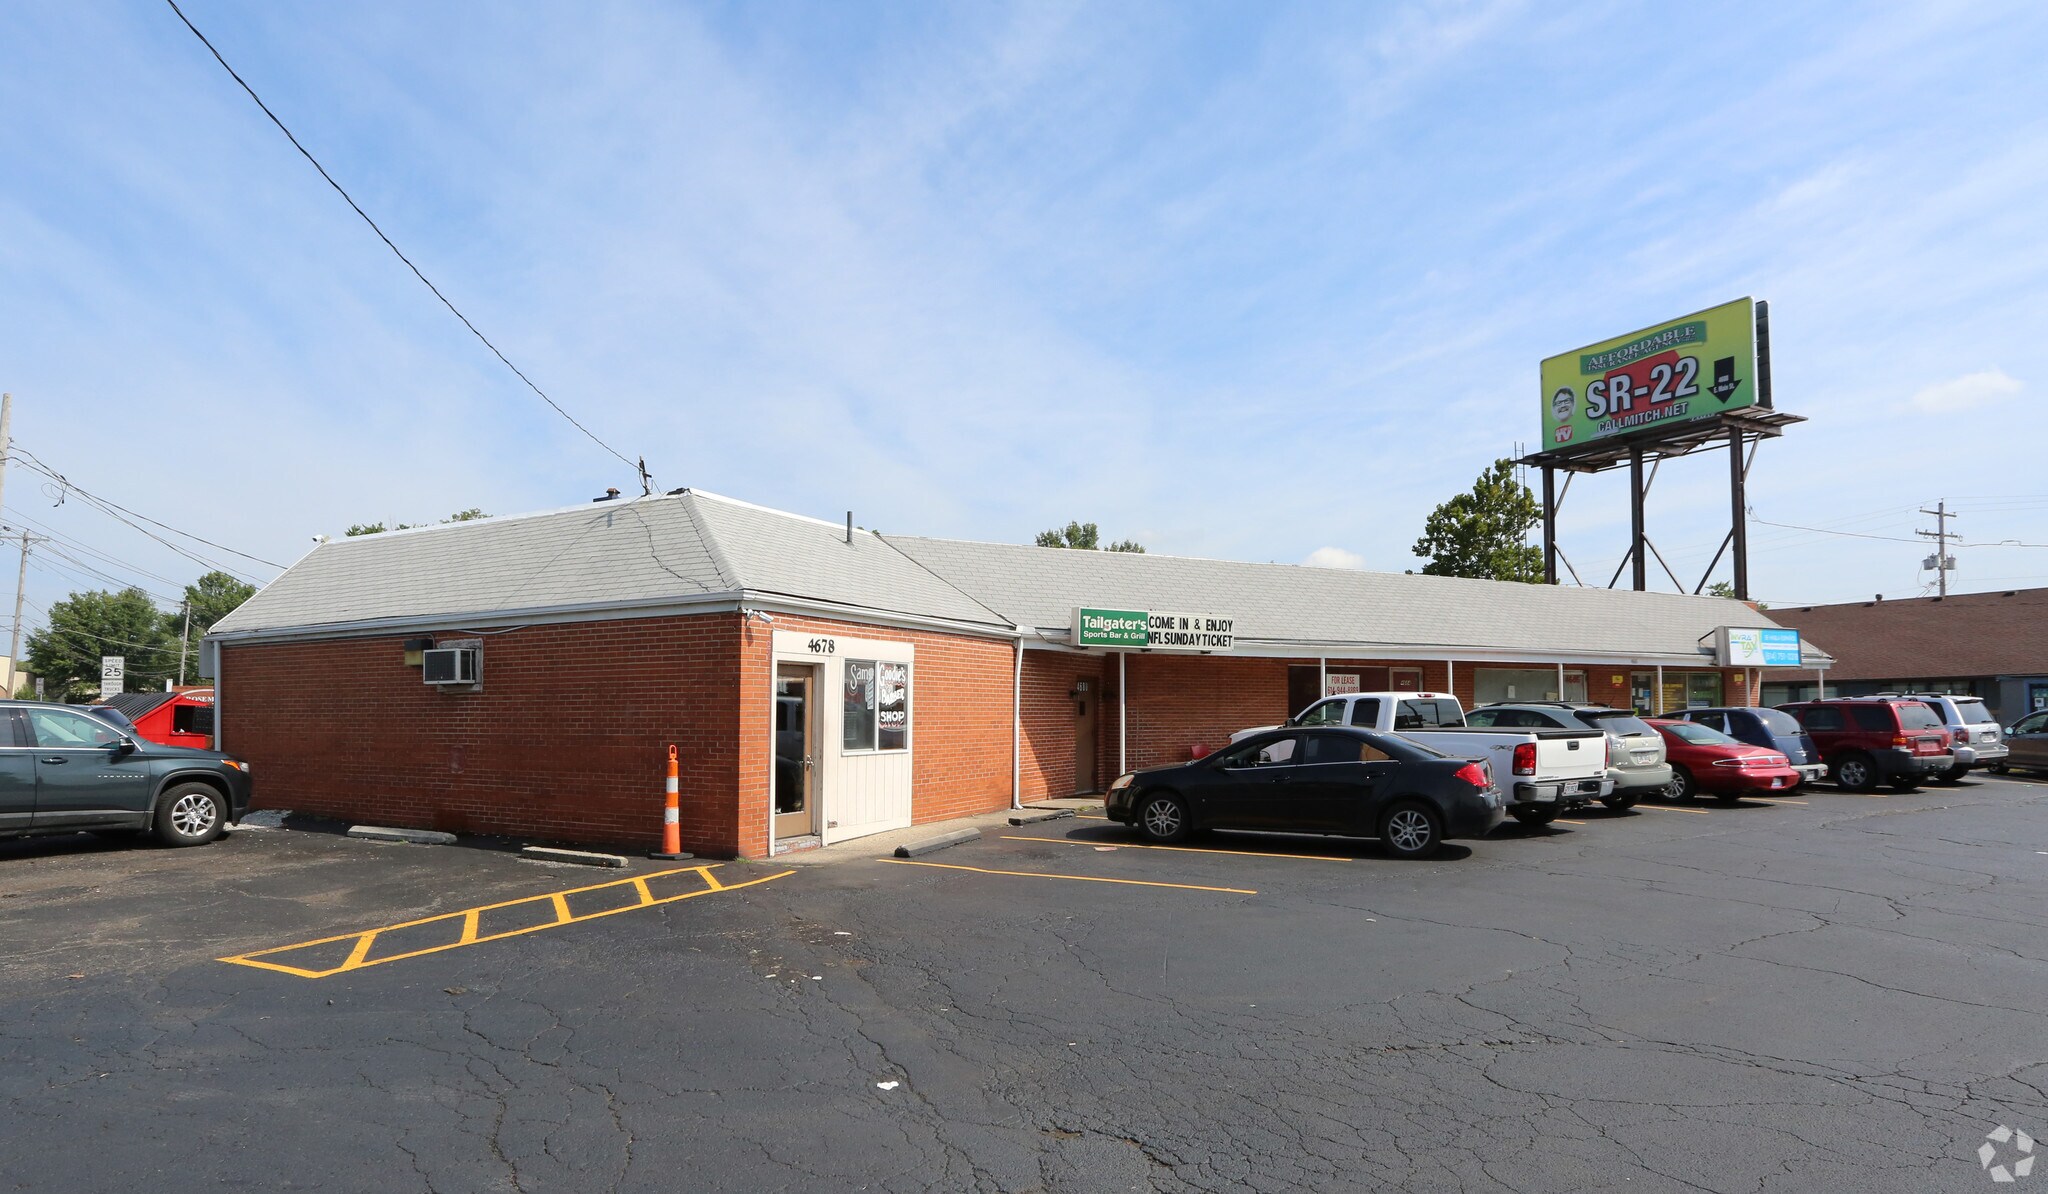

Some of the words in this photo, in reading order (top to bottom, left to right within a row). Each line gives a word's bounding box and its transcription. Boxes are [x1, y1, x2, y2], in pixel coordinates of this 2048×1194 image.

[1588, 325, 1696, 366] AFFORDABLE
[1588, 350, 1639, 371] INSURANCE
[1642, 337, 1681, 353] AGENCY
[1586, 356, 1699, 419] SR-22
[1597, 402, 1688, 432] CALLMITCH.NET
[1082, 615, 1147, 632] Tailgater's
[1149, 616, 1175, 630] COME
[1179, 617, 1189, 630] IN
[1194, 618, 1201, 631] &
[1206, 619, 1233, 632] ENJOY
[1083, 631, 1108, 640] Sports
[1130, 632, 1146, 640] Grill
[1147, 631, 1163, 644] NFL
[1164, 632, 1201, 646] SUNDAY
[1202, 634, 1233, 647] TICKET
[807, 638, 835, 653] 4678
[104, 668, 122, 677] 25
[1331, 676, 1340, 684] FOR
[1341, 676, 1355, 684] LEASE
[880, 710, 905, 722] SHOP
